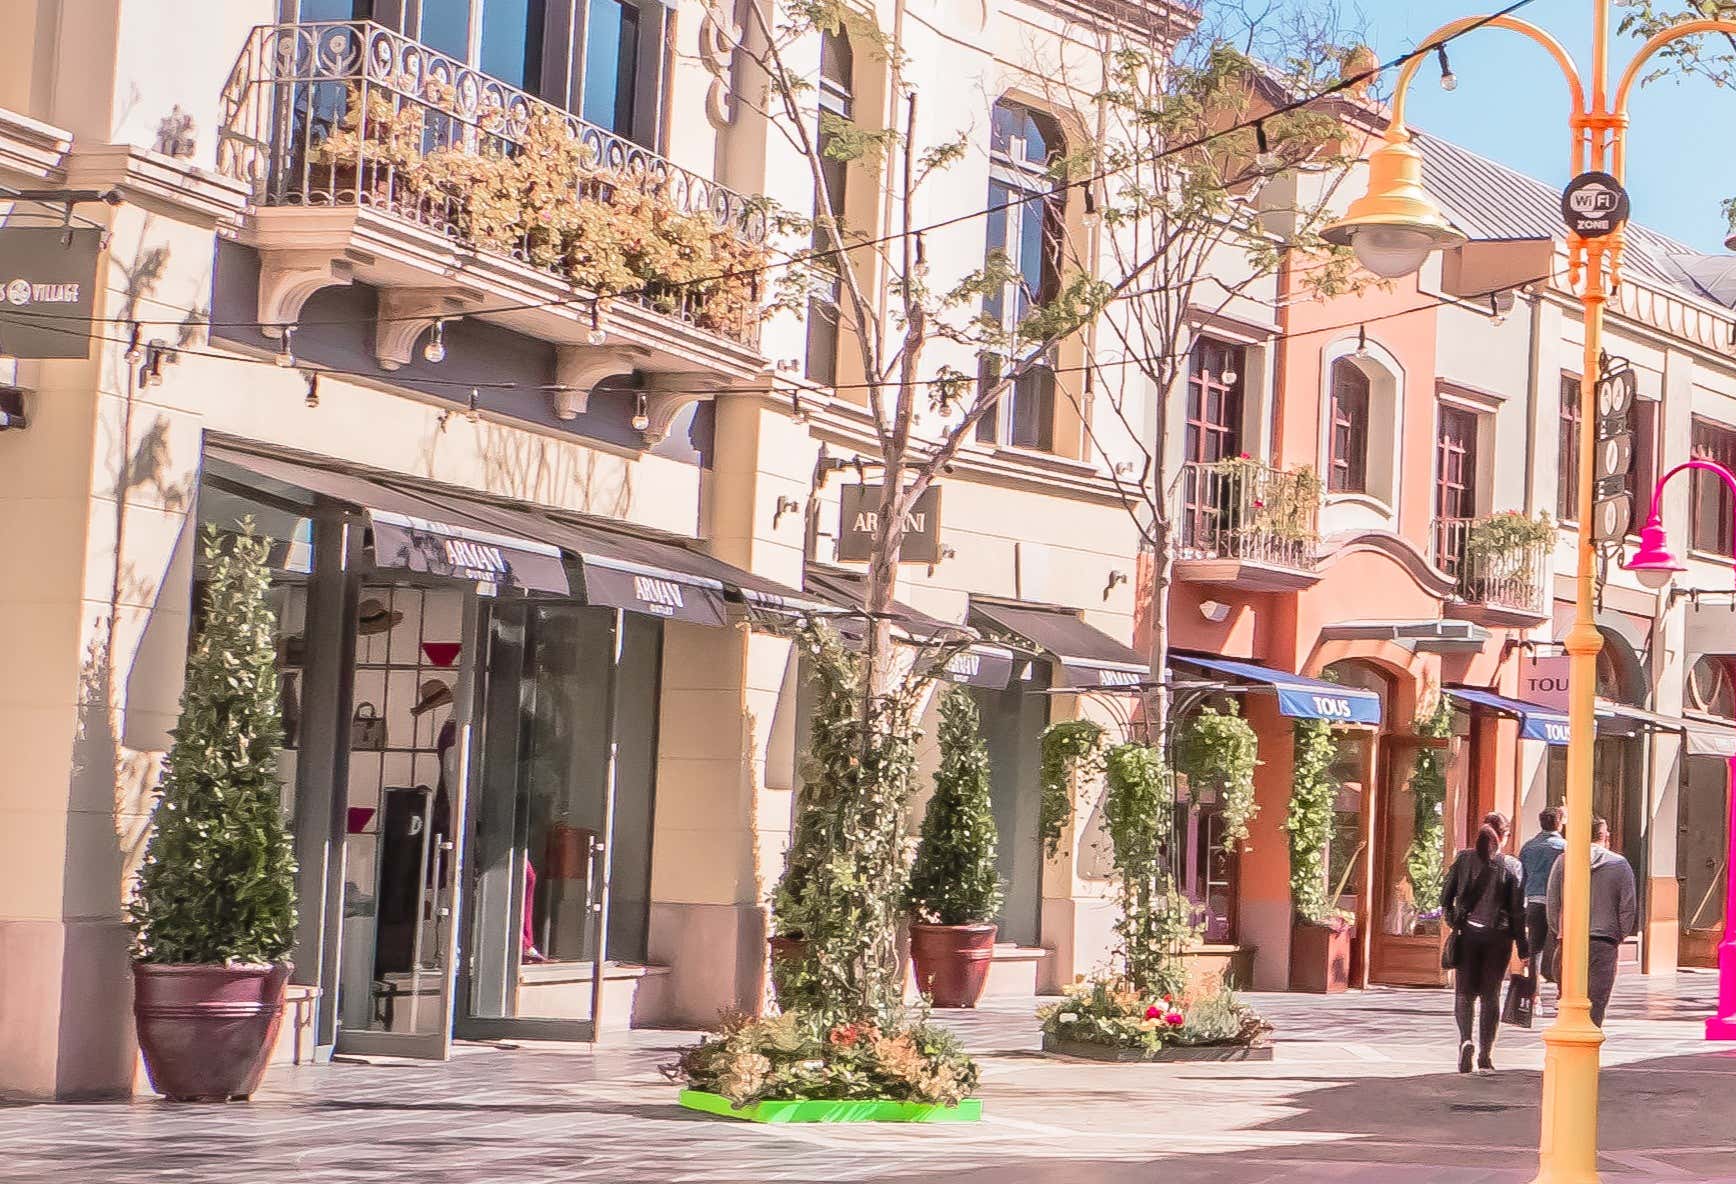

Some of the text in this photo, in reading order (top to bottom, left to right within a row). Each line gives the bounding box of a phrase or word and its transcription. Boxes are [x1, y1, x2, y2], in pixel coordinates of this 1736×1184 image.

[1576, 220, 1609, 229] ZONE
[852, 512, 926, 533] ARNI
[1527, 678, 1569, 691] TOU
[1312, 696, 1352, 718] TOUS
